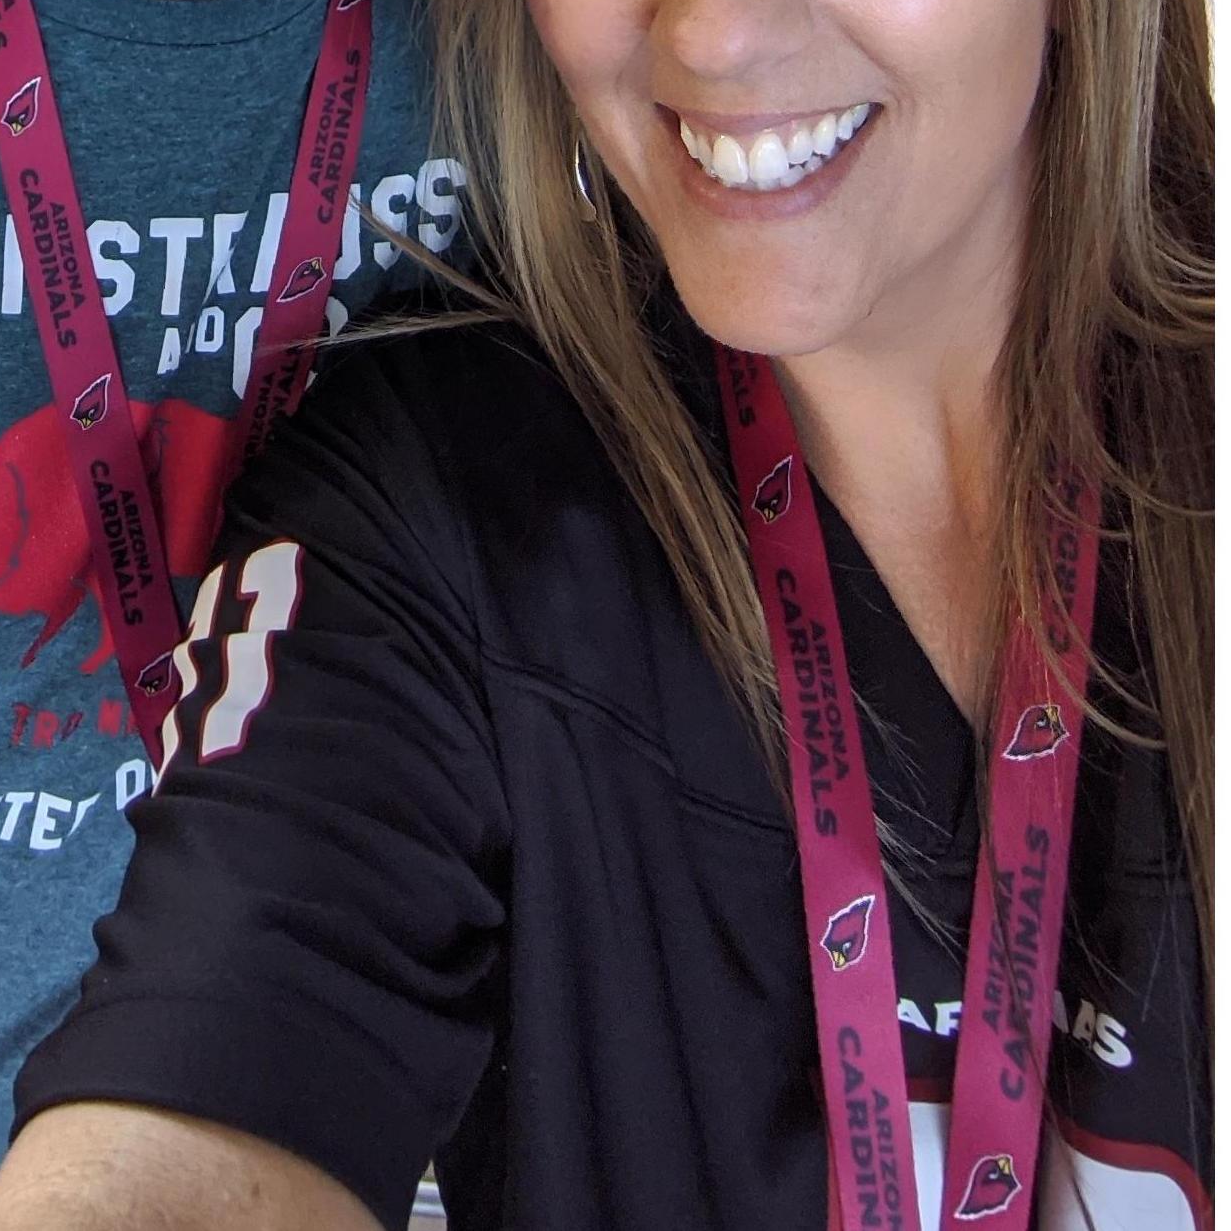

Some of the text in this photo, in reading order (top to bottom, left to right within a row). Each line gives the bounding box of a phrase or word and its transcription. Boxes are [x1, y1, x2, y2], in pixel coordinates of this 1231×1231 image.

[309, 80, 340, 187] ARIZONA
[316, 47, 362, 226] CARDINALS
[19, 167, 78, 351] CARDINALS
[50, 202, 86, 310] ARIZONA
[90, 459, 144, 628] CARDINALS
[119, 490, 154, 590] ARIZONA
[774, 567, 838, 838] CARDINALS
[811, 619, 851, 782] ARIZONA
